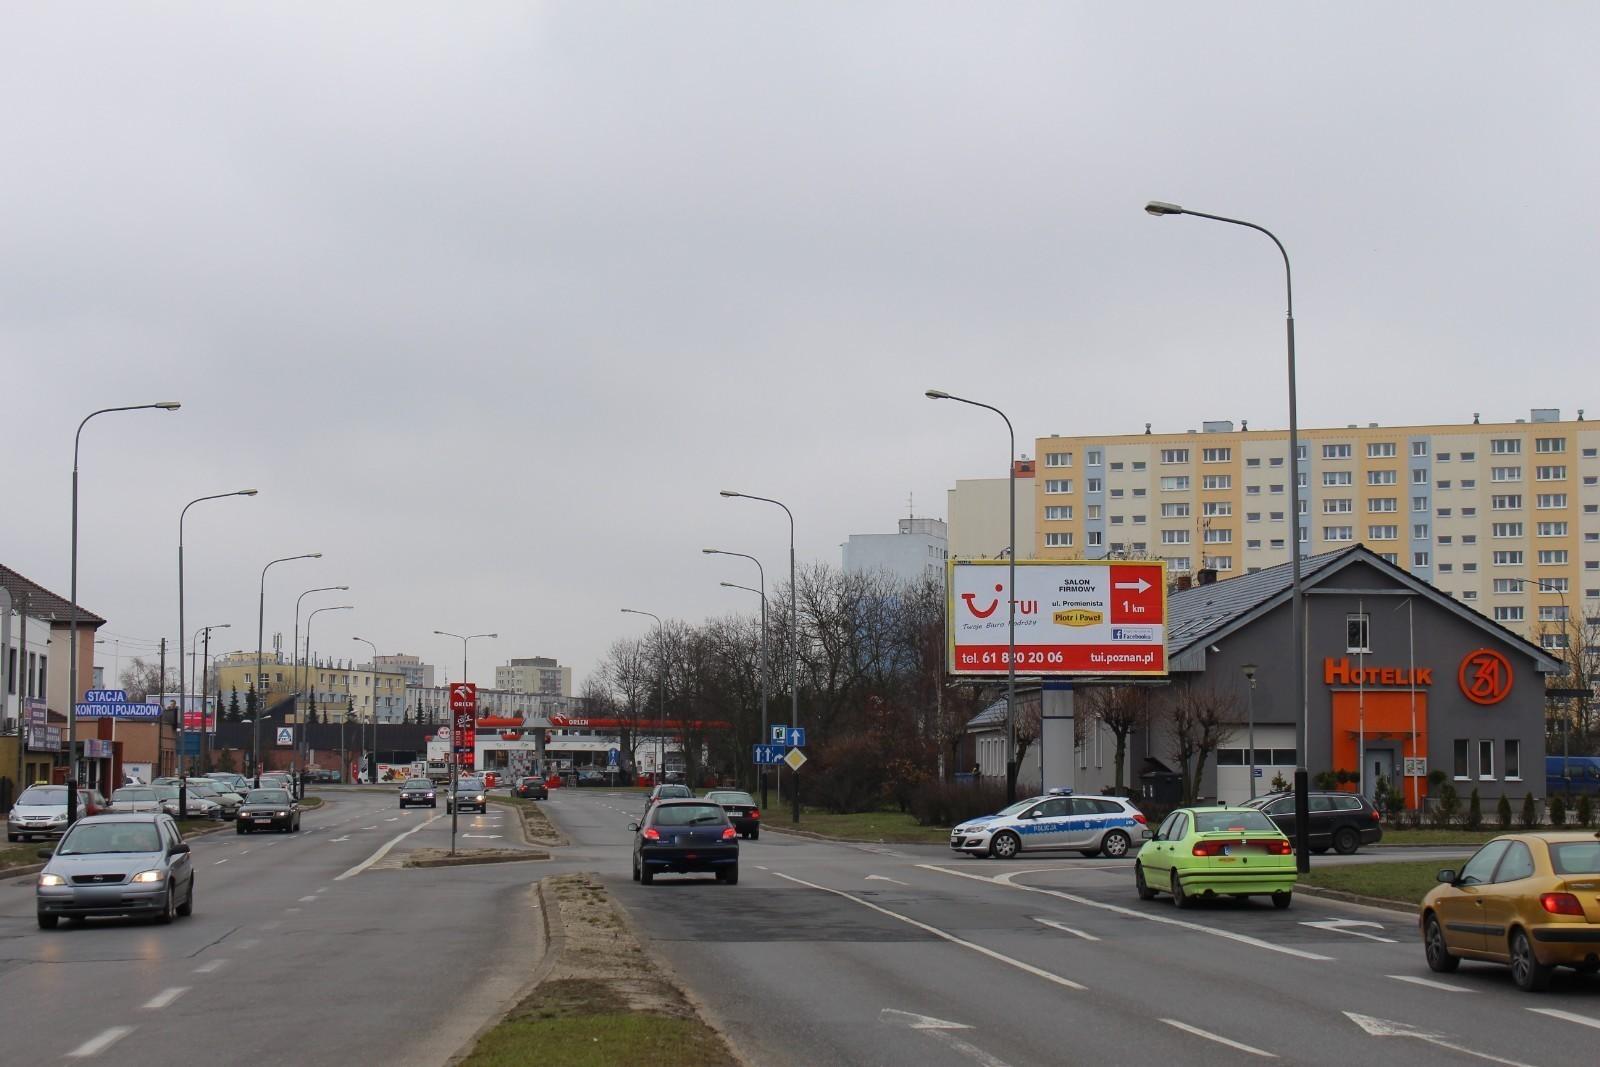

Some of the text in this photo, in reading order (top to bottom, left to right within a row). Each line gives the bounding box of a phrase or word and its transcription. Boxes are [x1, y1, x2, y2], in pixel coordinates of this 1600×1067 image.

[1122, 600, 1145, 613] 1 km
[985, 621, 1005, 629] Biuro
[961, 652, 979, 664] tel.
[982, 652, 996, 663] 61
[1028, 652, 1045, 663] 20
[1047, 652, 1063, 663] 06
[1090, 651, 1154, 665] tui.poznan.pl
[87, 691, 124, 702] STACJA
[75, 705, 114, 716] KONTROLI
